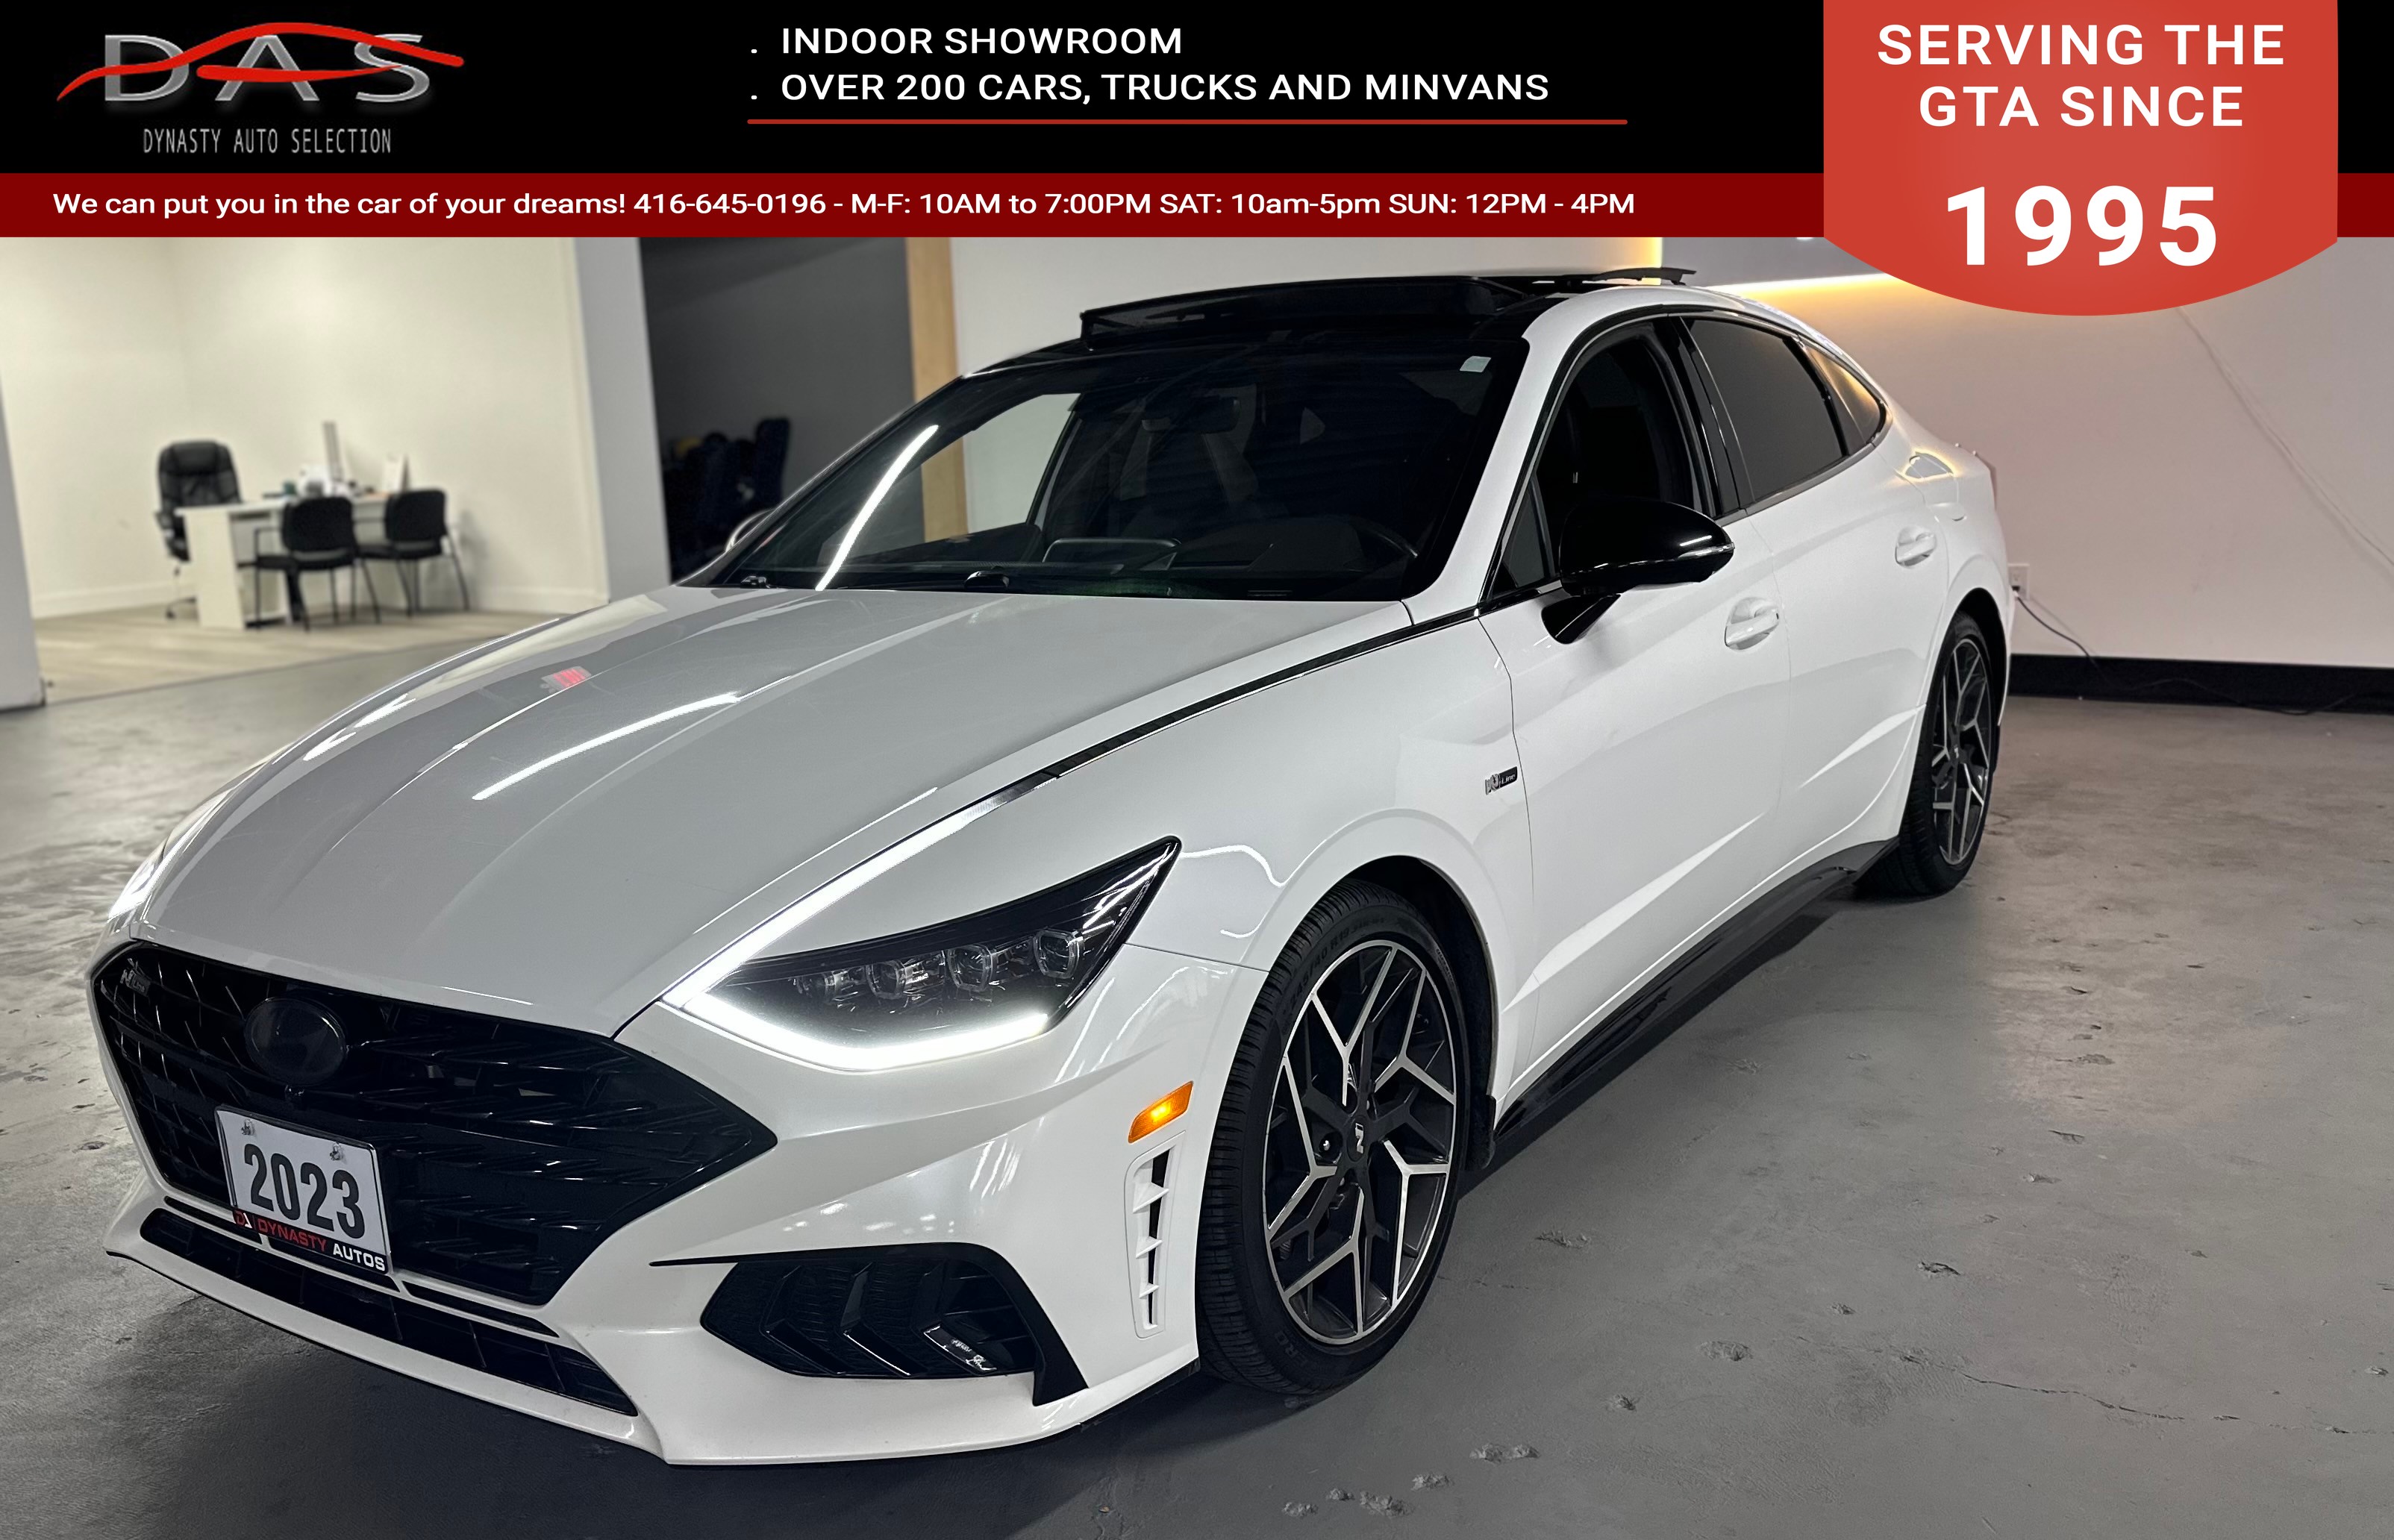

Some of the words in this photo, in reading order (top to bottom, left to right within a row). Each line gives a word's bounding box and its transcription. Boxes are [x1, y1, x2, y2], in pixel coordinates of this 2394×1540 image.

[244, 1143, 365, 1239] 2023
[258, 1218, 328, 1252] DYNASTY
[333, 1243, 385, 1271] AUTOS
